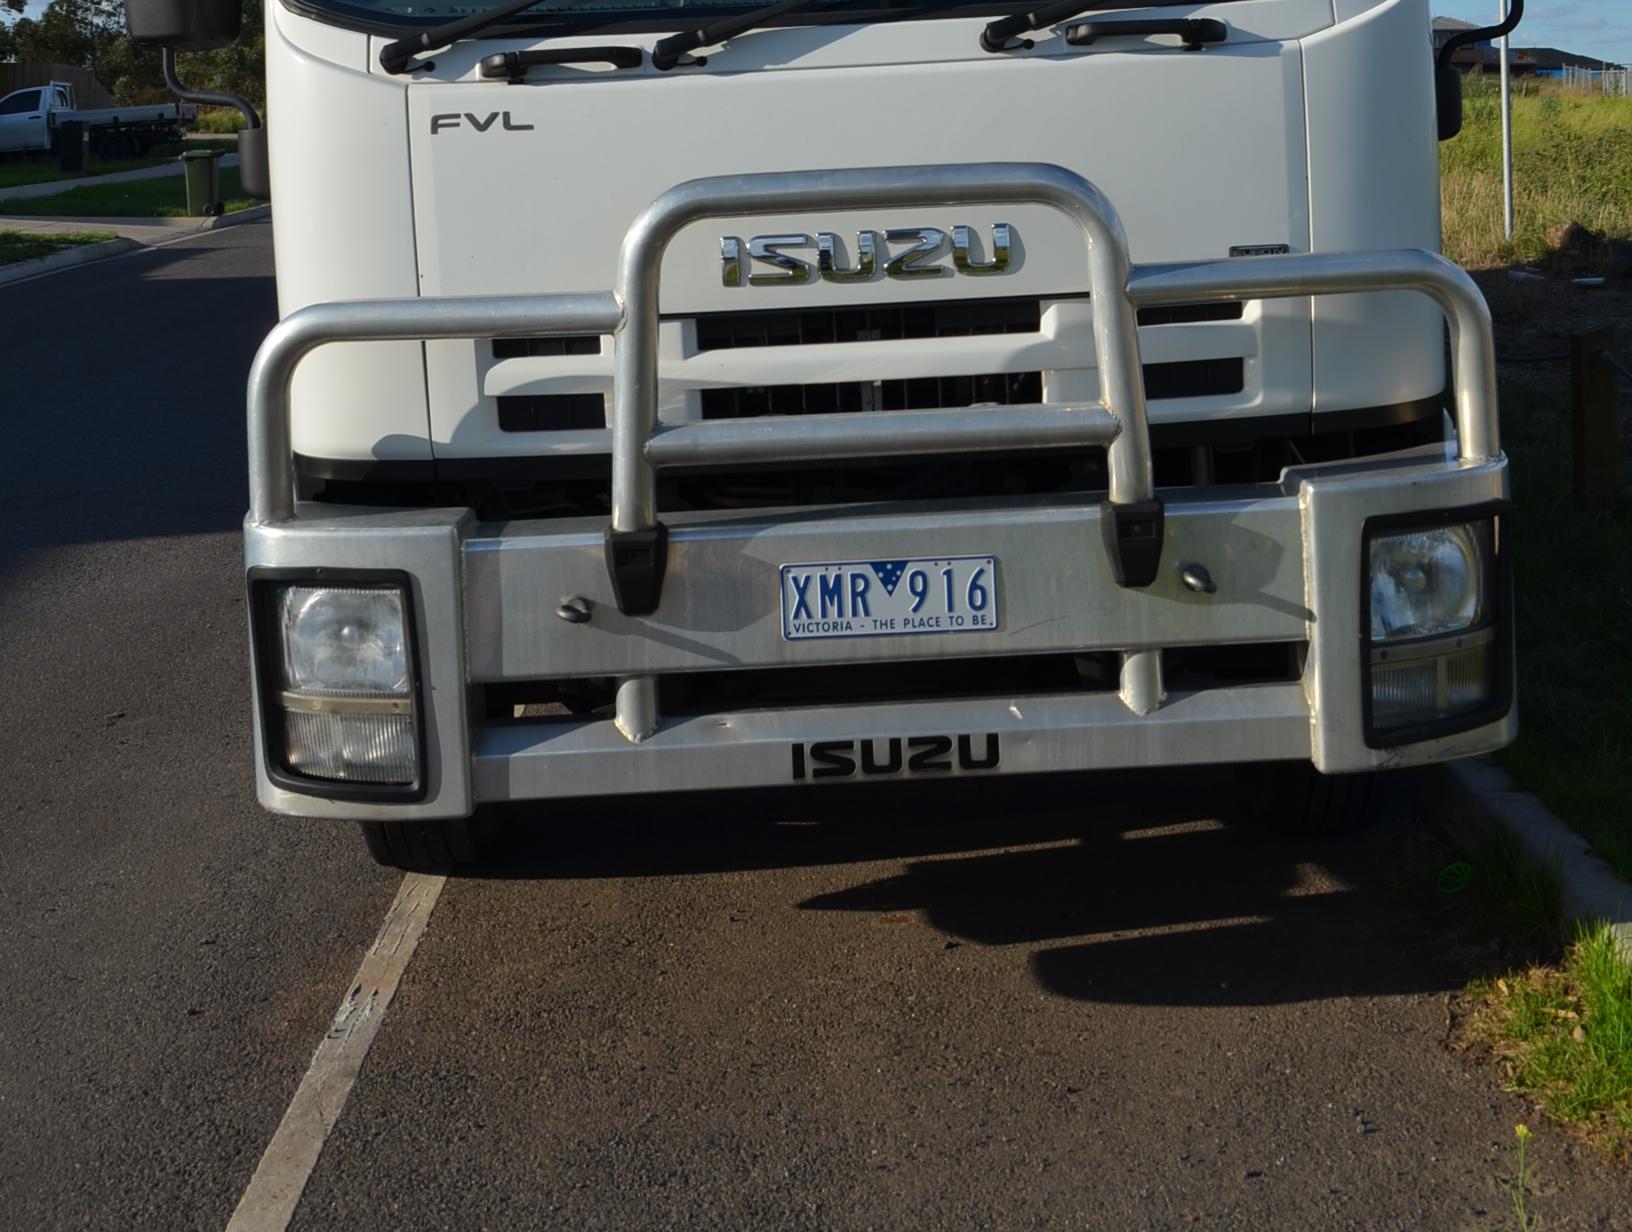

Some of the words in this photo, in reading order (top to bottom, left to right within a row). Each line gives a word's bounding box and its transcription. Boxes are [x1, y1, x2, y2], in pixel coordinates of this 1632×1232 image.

[430, 111, 535, 135] FVL
[720, 223, 1010, 287] ISUZU
[791, 572, 870, 619] XMR
[908, 567, 987, 614] 916
[793, 620, 853, 634] VICTORIA
[872, 619, 896, 630] THE
[903, 616, 941, 629] PLACE
[949, 615, 965, 627] TO
[972, 614, 987, 626] BE
[791, 732, 1000, 780] ISUZU
